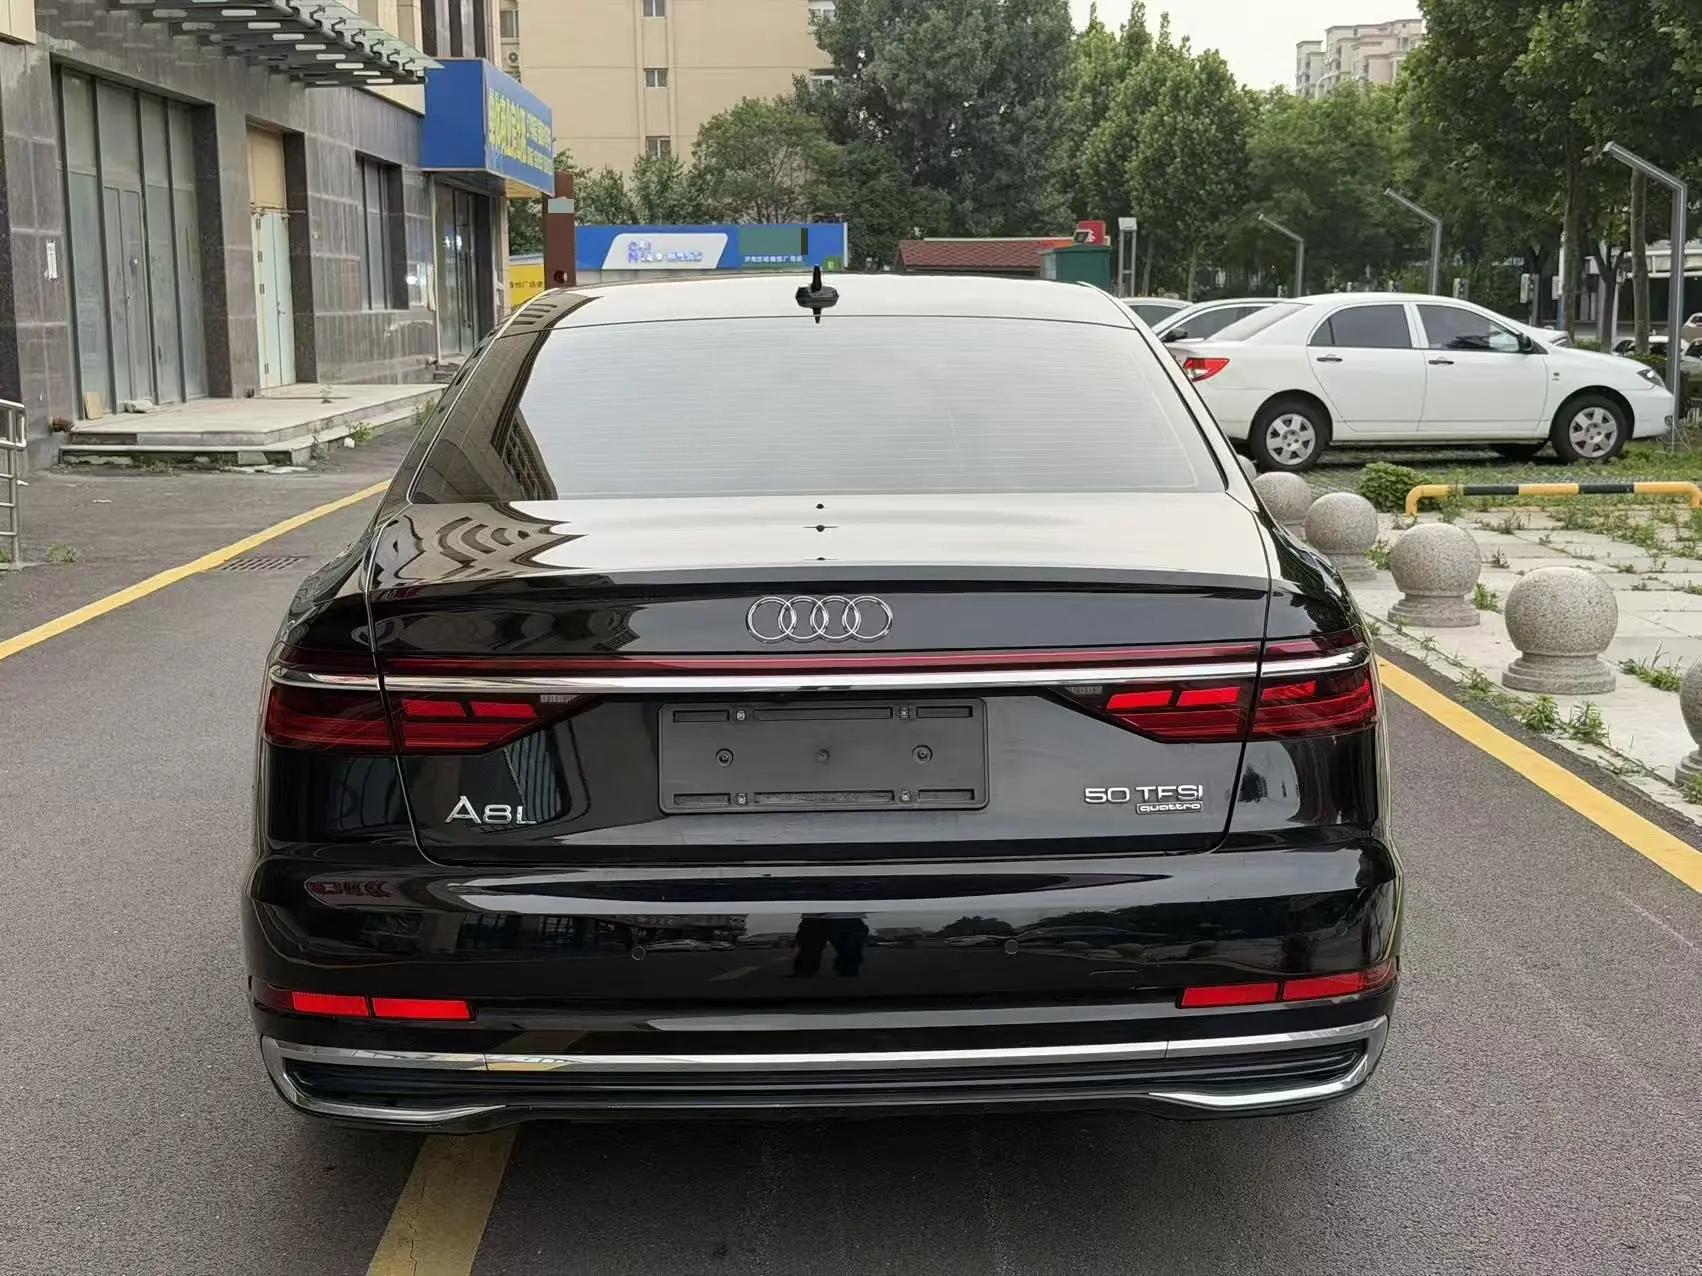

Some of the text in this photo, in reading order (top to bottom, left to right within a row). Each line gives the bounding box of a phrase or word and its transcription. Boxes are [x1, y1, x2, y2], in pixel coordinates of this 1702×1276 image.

[1084, 784, 1203, 803] 50 TFSI
[444, 795, 537, 825] A8L
[1139, 803, 1201, 812] quattro
